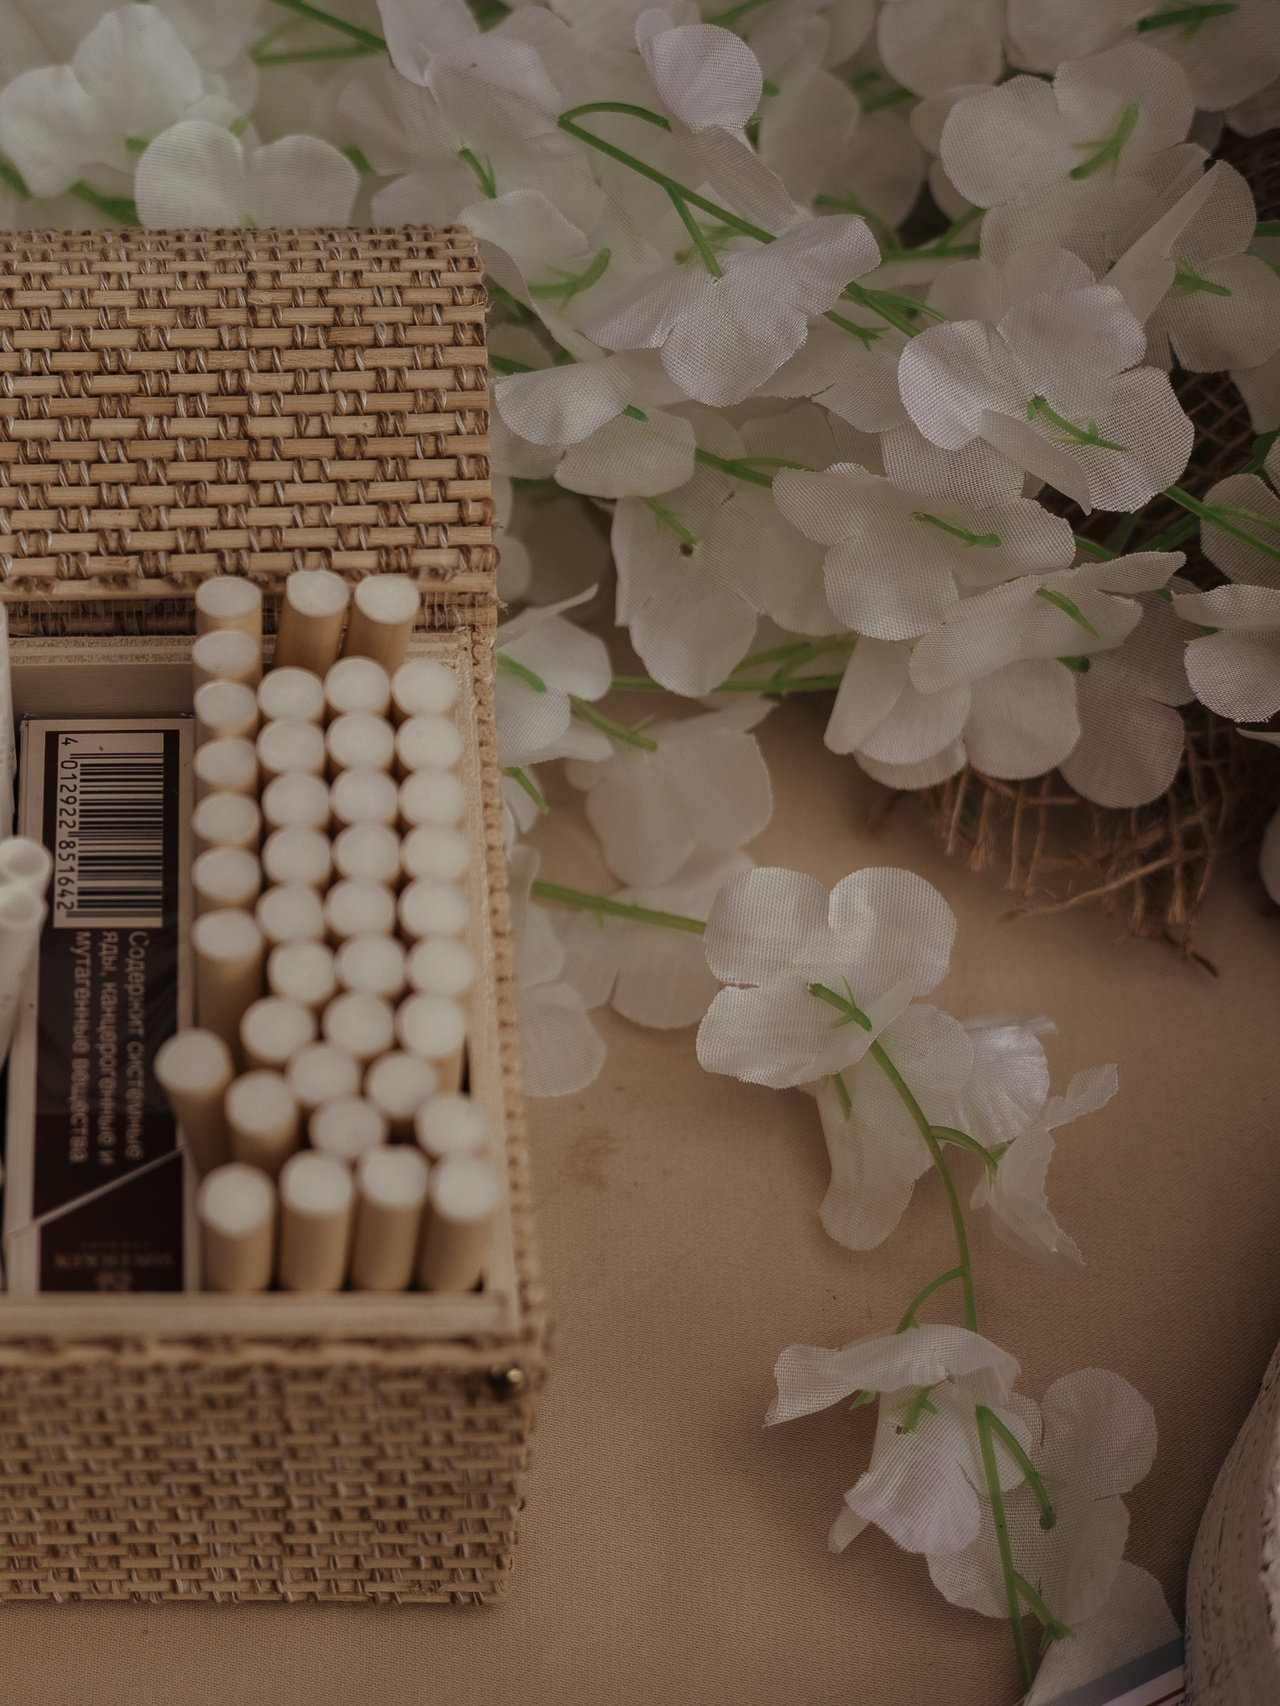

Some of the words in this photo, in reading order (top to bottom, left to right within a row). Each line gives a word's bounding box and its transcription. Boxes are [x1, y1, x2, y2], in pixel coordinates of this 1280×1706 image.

[61, 736, 78, 746] 4
[59, 760, 78, 829] 012922
[57, 840, 76, 910] 851642
[69, 930, 92, 1054] мутагенные
[97, 930, 119, 977] яды,
[124, 930, 150, 1037] Содержит
[95, 981, 119, 1147] канцерогенные
[124, 1041, 145, 1160] системные
[67, 1057, 90, 1164] вещества
[97, 1150, 115, 1166] и
